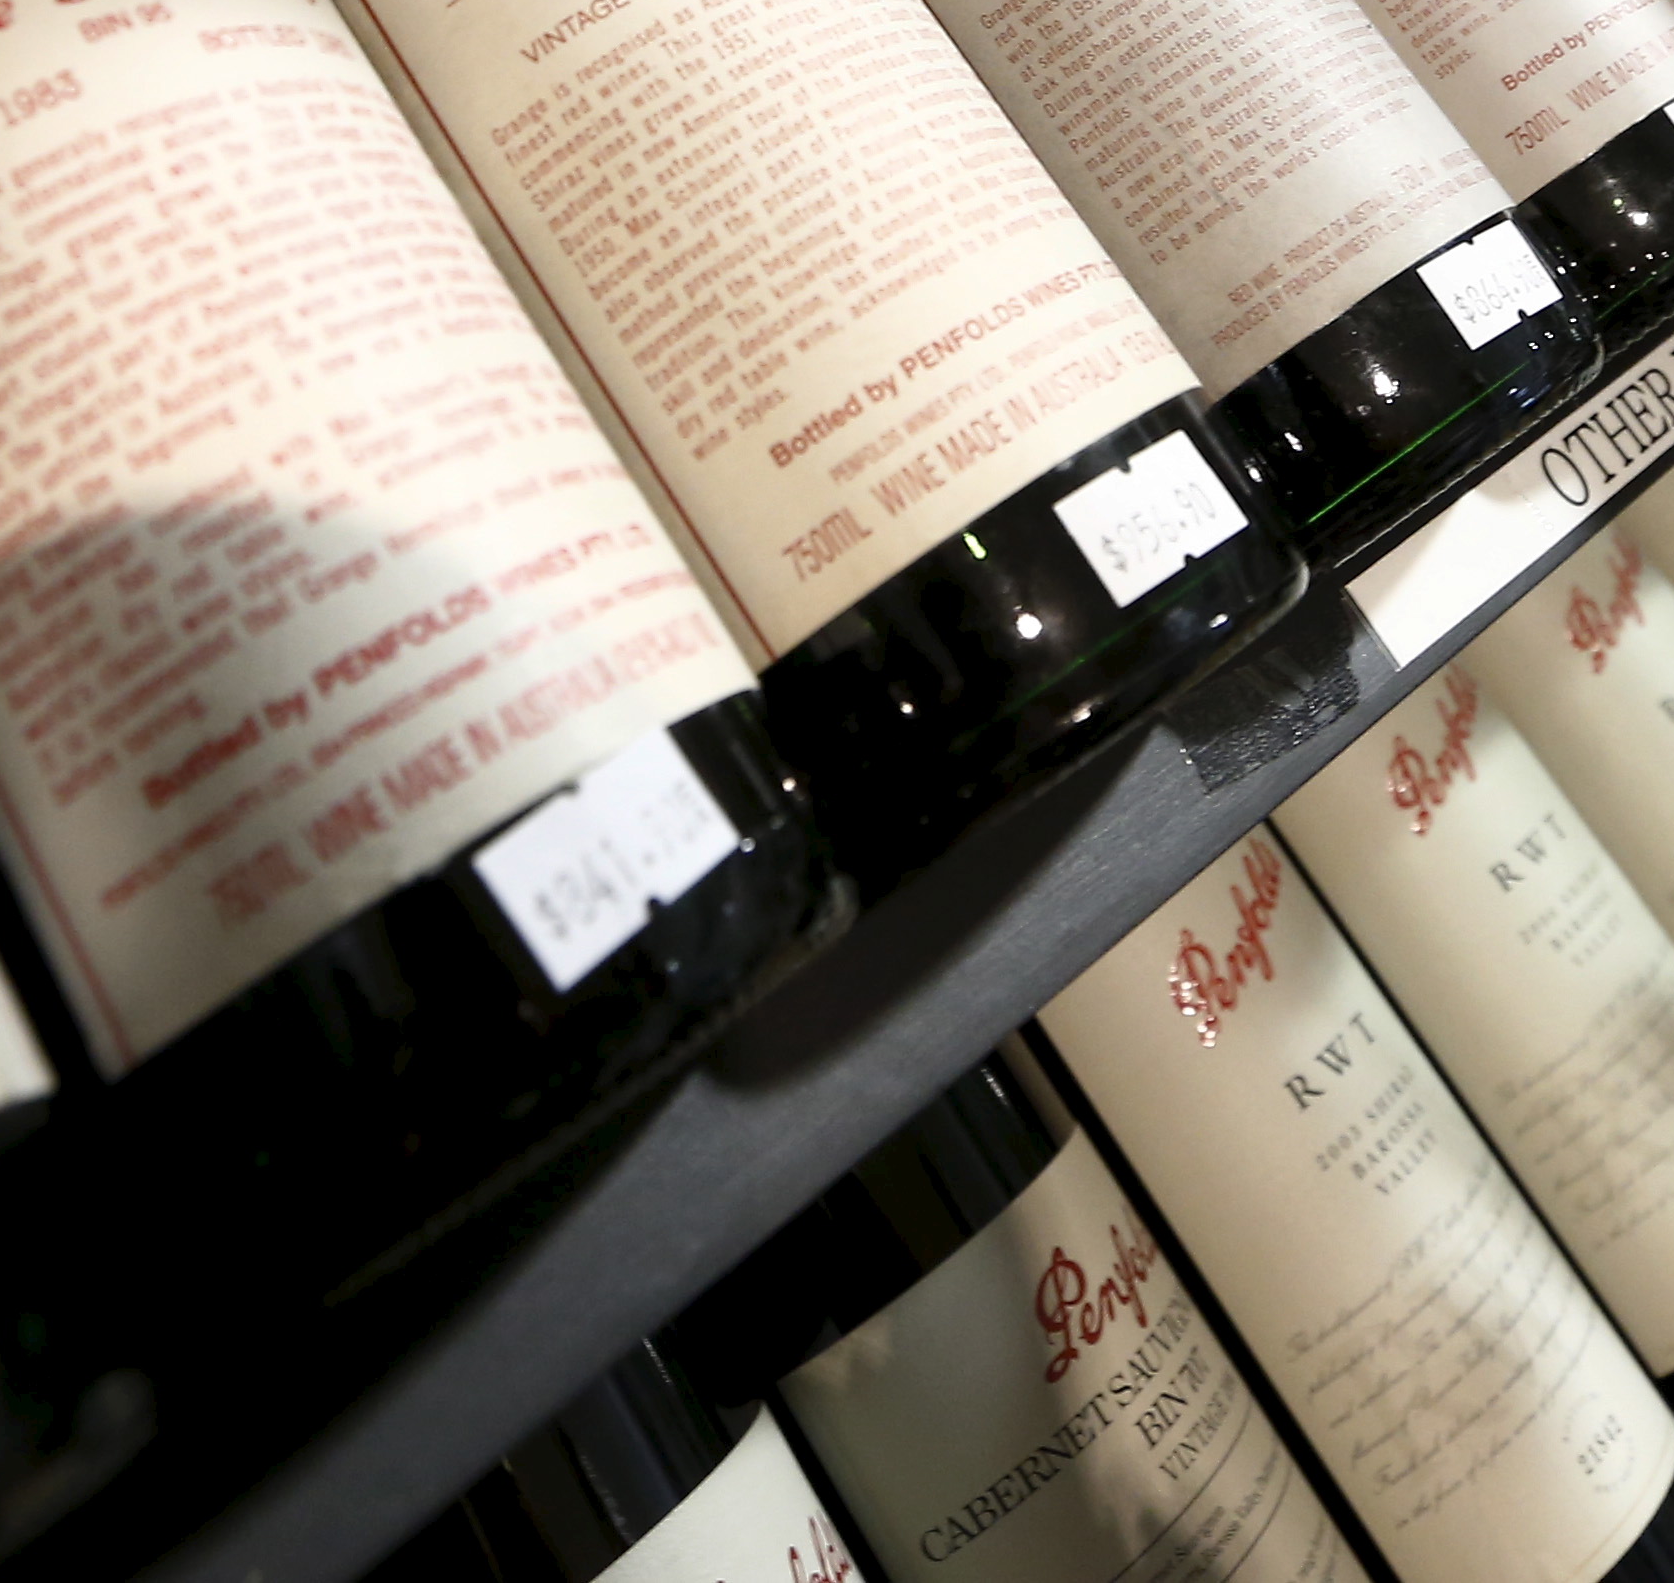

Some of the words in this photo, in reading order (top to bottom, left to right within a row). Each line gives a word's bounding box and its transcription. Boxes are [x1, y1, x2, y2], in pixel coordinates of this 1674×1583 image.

[991, 22, 1018, 48] red
[1005, 34, 1037, 66] with
[1036, 15, 1064, 41] the
[1017, 62, 1037, 83] at
[1035, 23, 1094, 69] selected
[1030, 72, 1060, 102] oak
[1058, 20, 1137, 83] hogsheads
[1500, 40, 1565, 93] Bottled
[1562, 28, 1588, 51] by
[488, 92, 551, 149] Grange
[552, 78, 571, 99] is
[574, 17, 669, 87] recognised
[1565, 67, 1617, 115] WINE
[502, 119, 556, 167] finest
[556, 92, 592, 126] red
[765, 391, 865, 471] Bottled
[861, 369, 901, 407] by
[896, 293, 1027, 382] PENFOLDS
[867, 449, 947, 522] WINE
[934, 405, 1012, 477] MADE
[1135, 1373, 1189, 1451] BIN
[920, 1390, 1114, 1565] CABERNET
